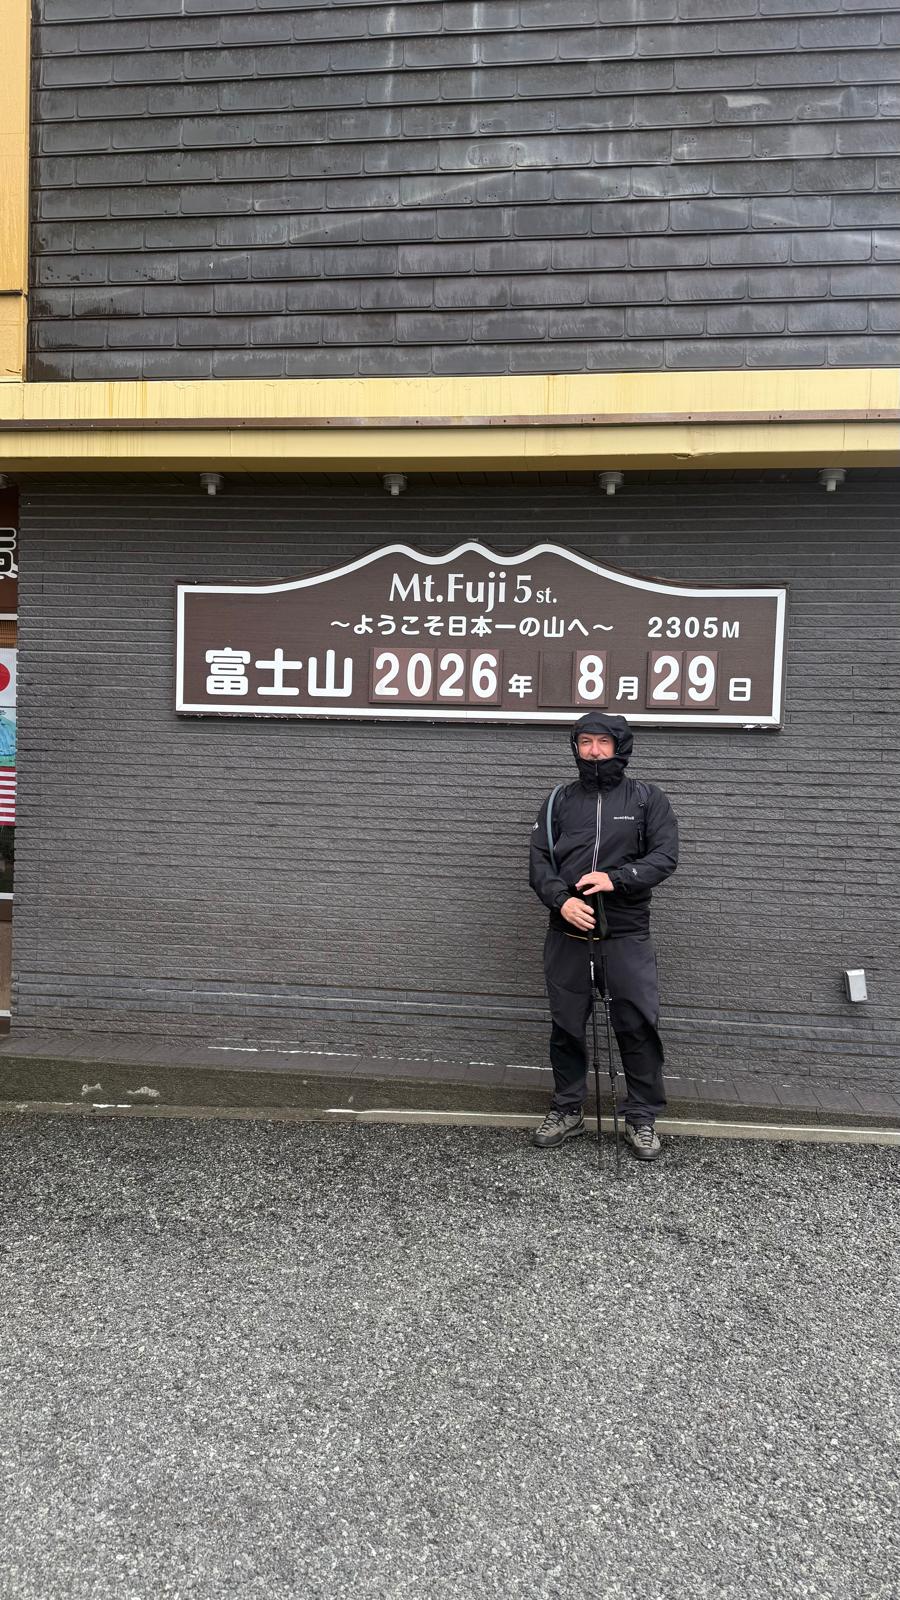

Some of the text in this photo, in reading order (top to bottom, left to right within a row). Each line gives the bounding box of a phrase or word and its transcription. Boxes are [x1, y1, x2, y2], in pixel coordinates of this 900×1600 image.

[388, 571, 558, 613] Mt.Fuji 5 st.
[205, 646, 353, 698] 富士山
